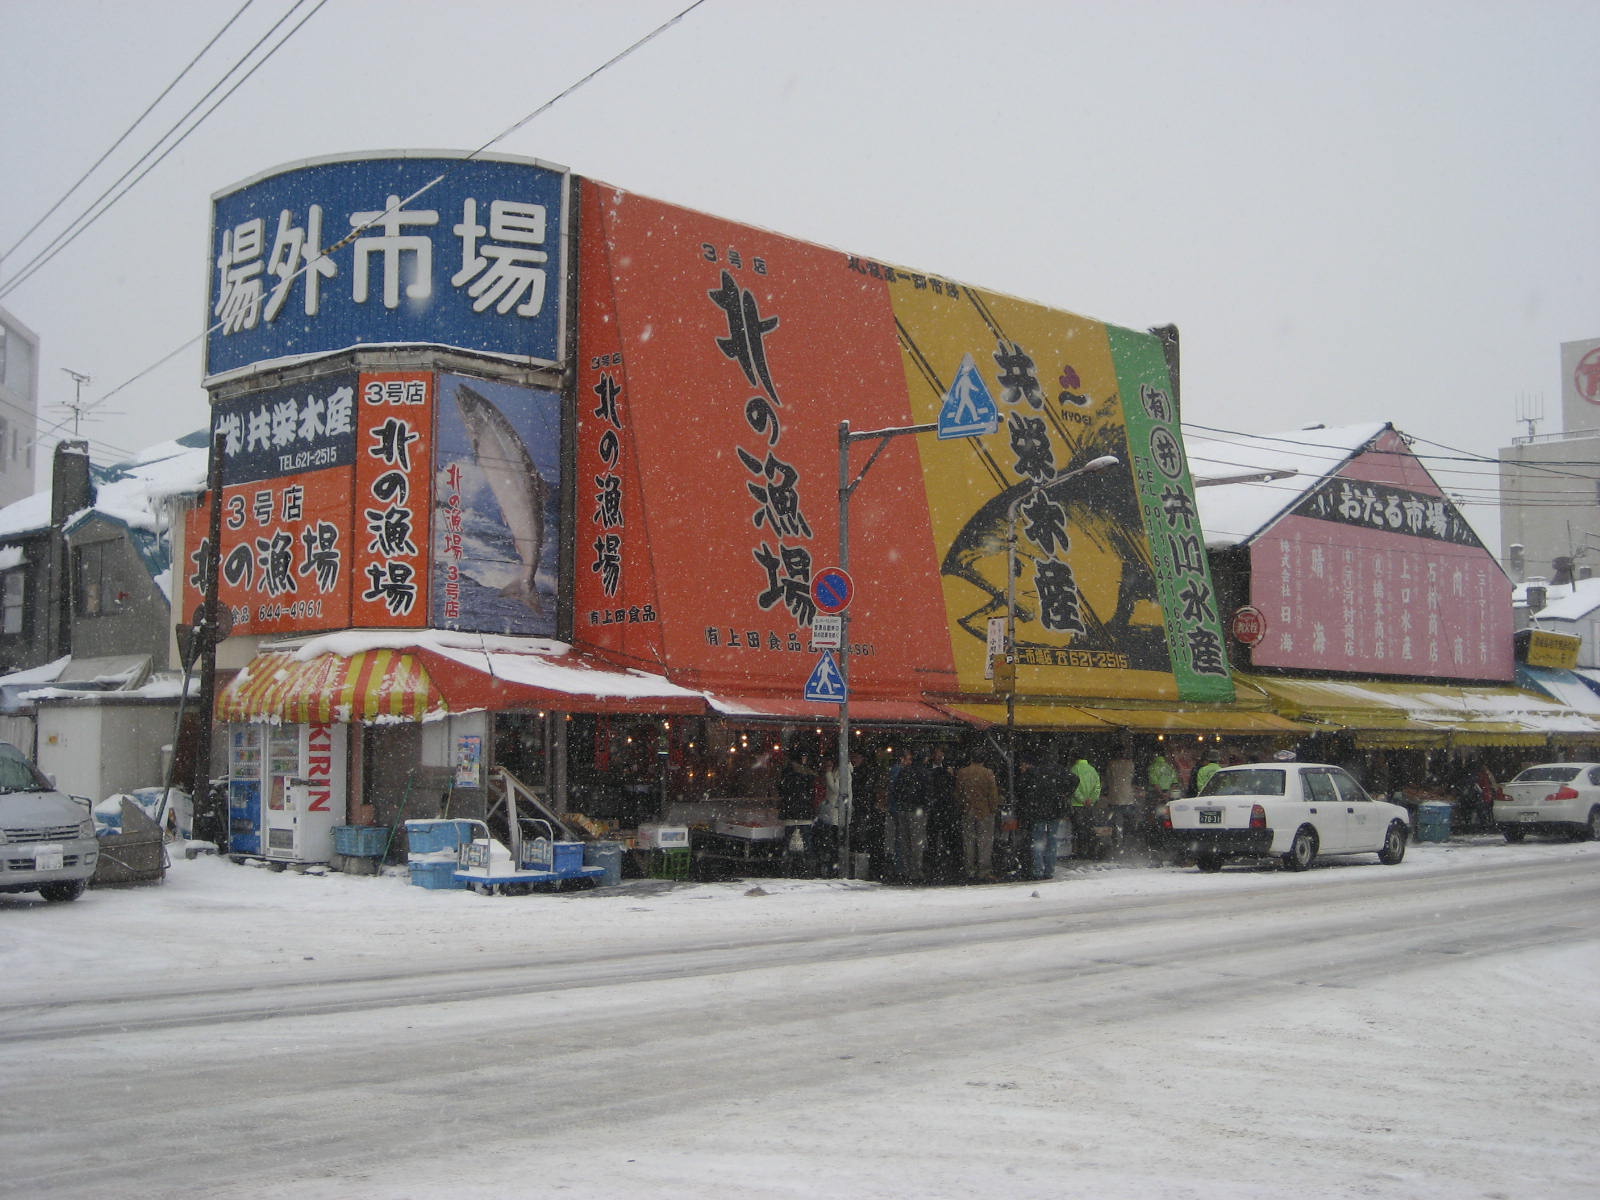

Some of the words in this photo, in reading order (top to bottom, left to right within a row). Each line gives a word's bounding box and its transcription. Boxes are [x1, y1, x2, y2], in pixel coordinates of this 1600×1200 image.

[214, 195, 548, 336] 場外市場
[702, 242, 767, 275] 3号店
[591, 353, 623, 370] 3号店
[365, 382, 426, 404] 3号店
[708, 269, 818, 629] 北の漁場
[227, 484, 305, 530] 3号店
[444, 463, 464, 562] 北の漁場
[592, 371, 624, 597] 北の漁場
[993, 338, 1087, 635] 共栄水産
[1338, 482, 1448, 539] おたる市場
[363, 417, 418, 616] 北の漁場
[258, 599, 323, 622] 644-4961
[444, 565, 461, 619] 3号店
[1070, 651, 1129, 669] 621-2515
[308, 722, 332, 813] KIRIN
